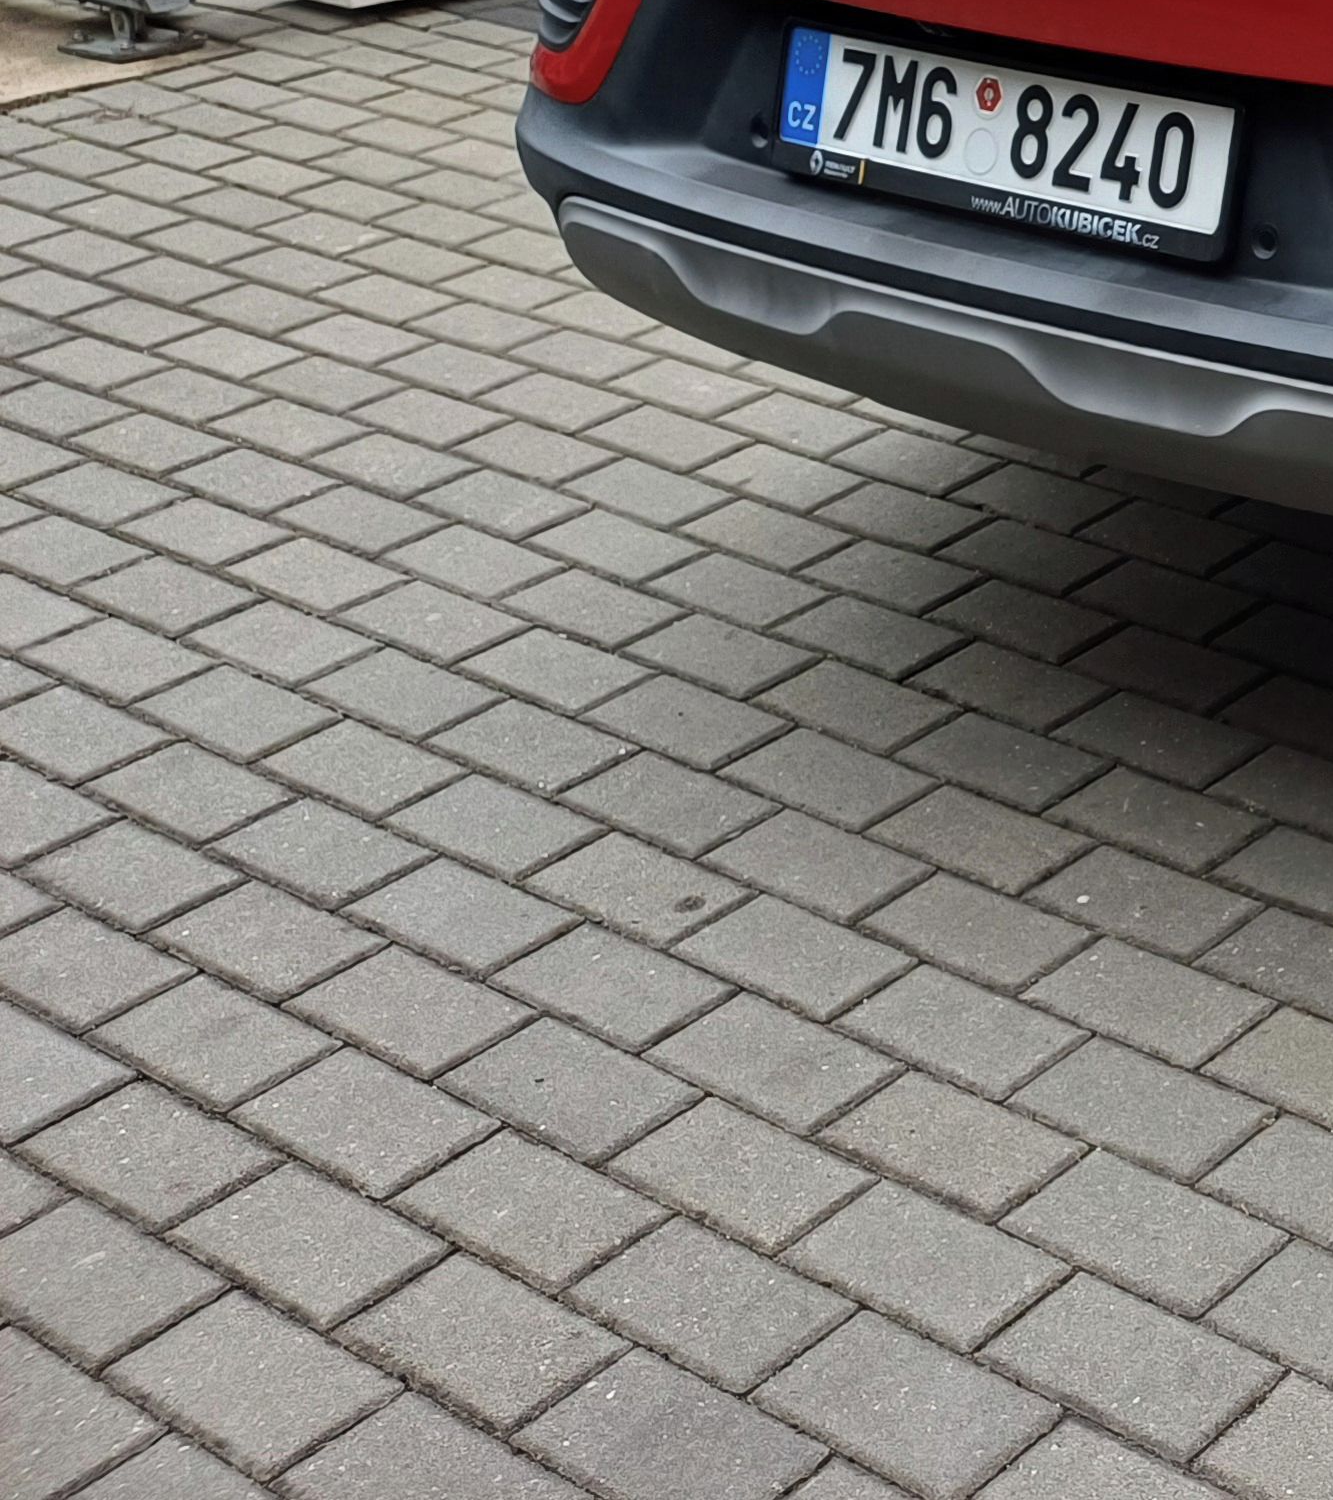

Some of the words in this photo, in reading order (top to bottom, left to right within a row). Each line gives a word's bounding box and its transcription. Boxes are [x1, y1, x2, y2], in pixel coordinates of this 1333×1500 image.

[786, 100, 815, 132] CZ
[832, 48, 958, 160] 7M6
[1009, 84, 1195, 209] 8240
